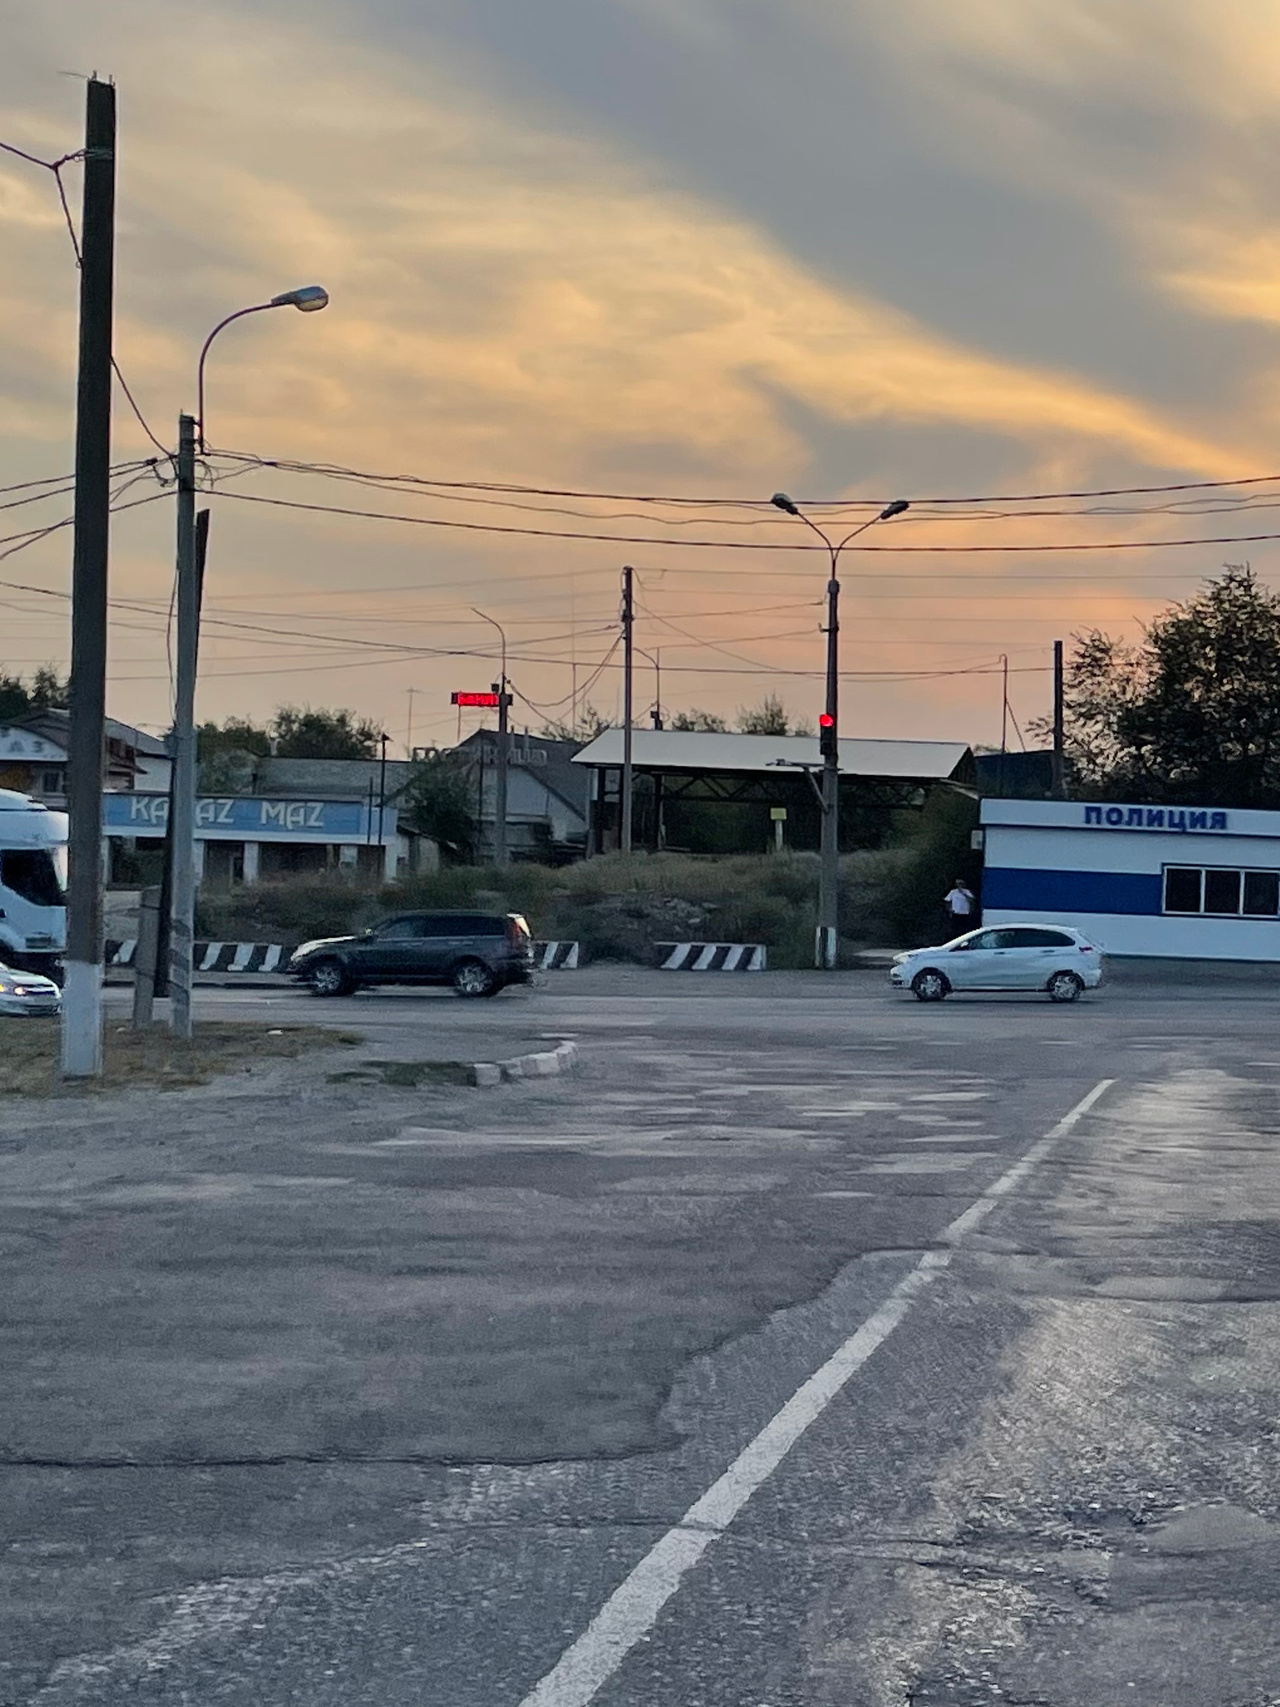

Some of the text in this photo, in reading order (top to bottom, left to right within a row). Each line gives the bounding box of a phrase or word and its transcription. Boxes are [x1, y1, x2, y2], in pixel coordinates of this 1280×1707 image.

[131, 797, 325, 830] KAAZ MAZ
[1084, 806, 1227, 832] ПОЛИЦИЯ
